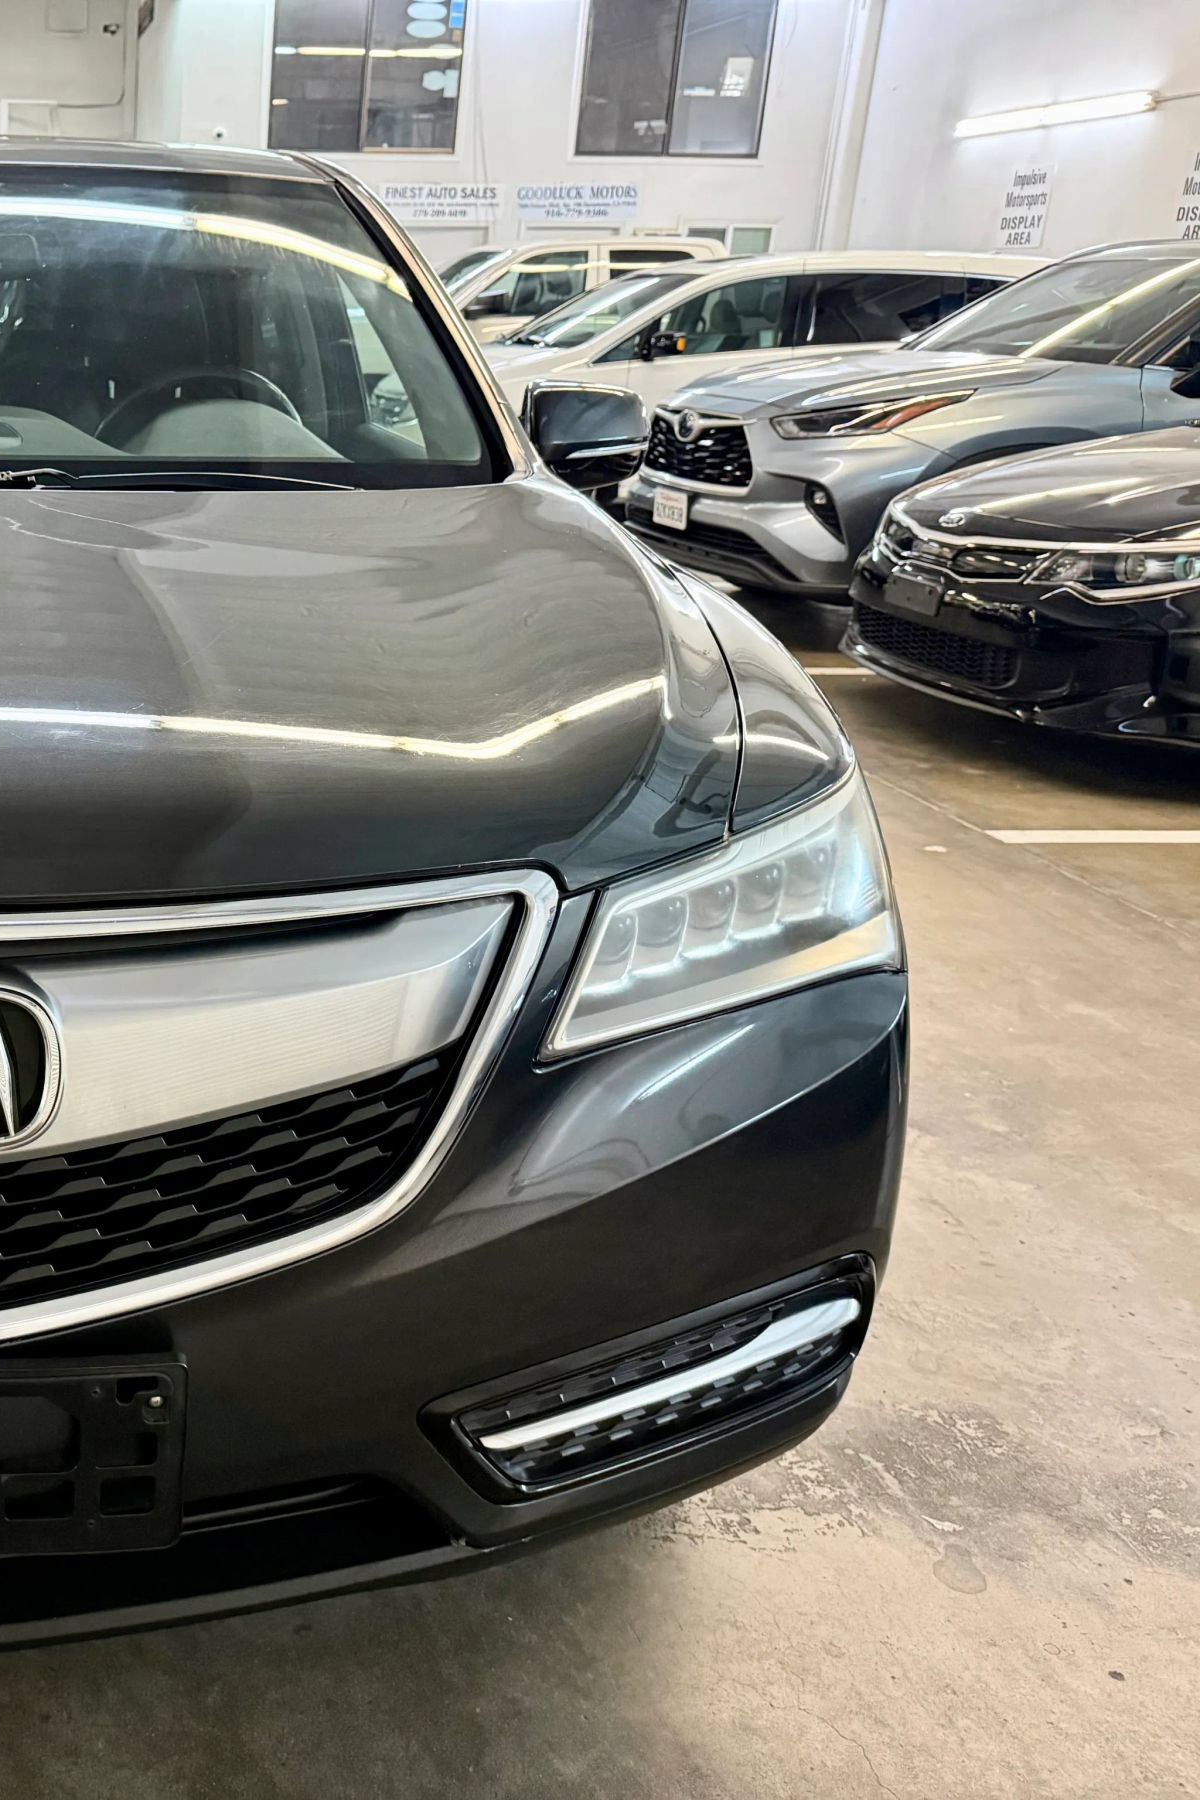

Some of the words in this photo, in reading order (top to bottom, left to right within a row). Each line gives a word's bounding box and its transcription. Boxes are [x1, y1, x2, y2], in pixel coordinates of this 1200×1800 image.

[385, 186, 425, 199] FINEST
[426, 187, 458, 200] AUTO
[460, 187, 497, 200] SALES
[517, 186, 584, 200] GOODLUCK
[590, 186, 638, 199] MOTORS
[1000, 214, 1043, 230] DISPLAY
[1005, 231, 1031, 246] AREA
